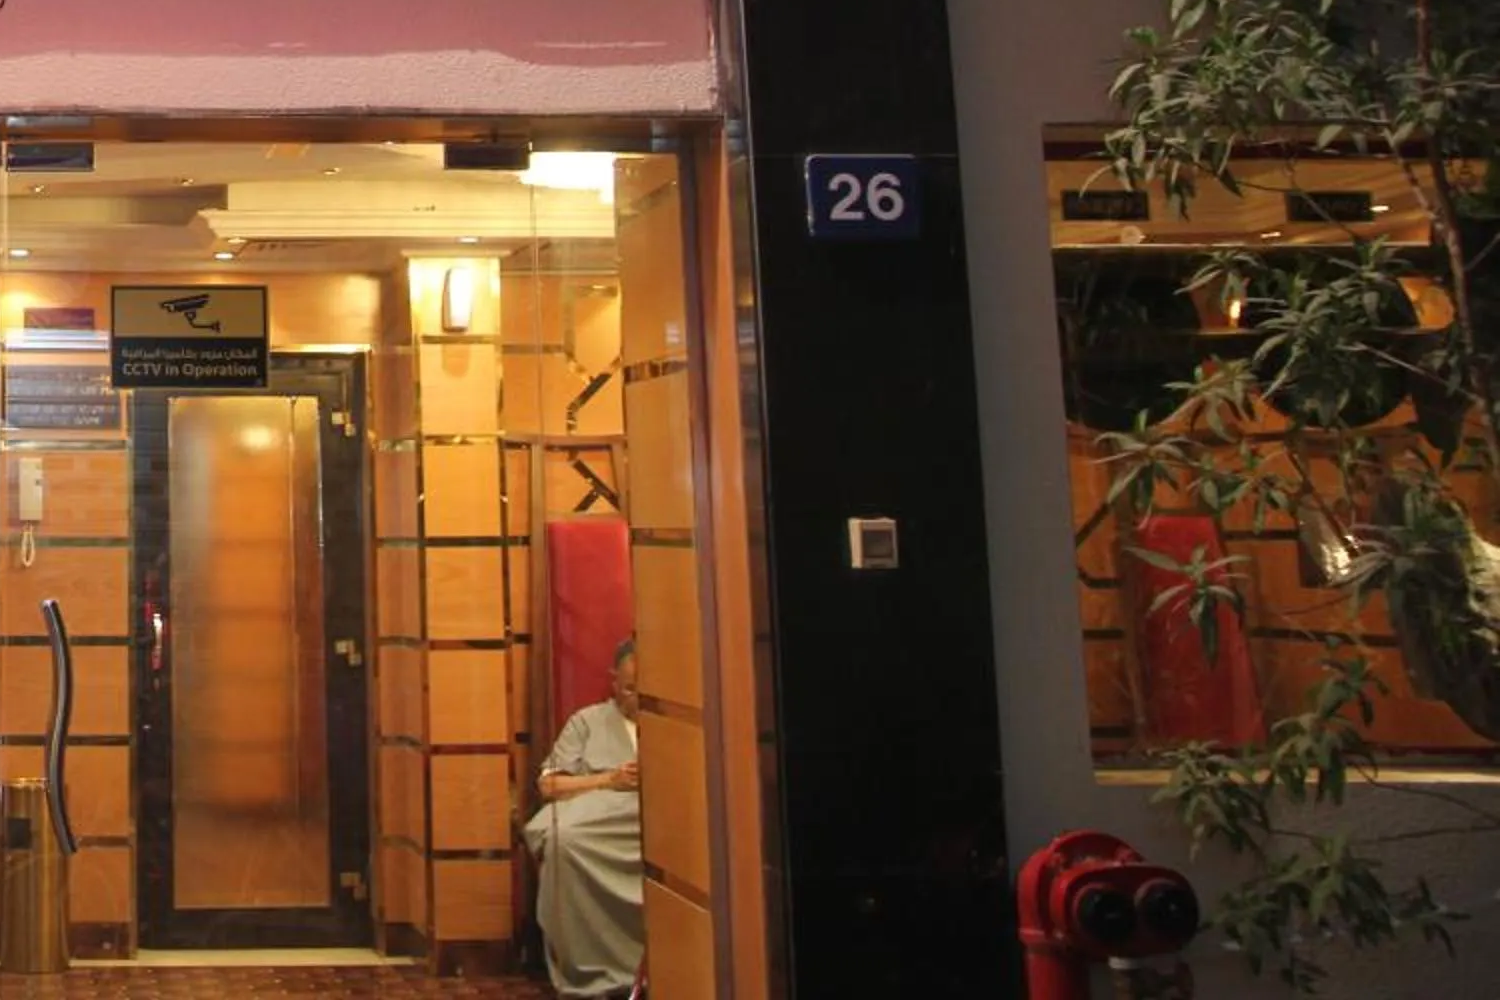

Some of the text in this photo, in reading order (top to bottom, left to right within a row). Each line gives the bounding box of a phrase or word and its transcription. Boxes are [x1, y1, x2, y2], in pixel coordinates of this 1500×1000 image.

[827, 171, 905, 221] 26
[122, 363, 258, 379] CCTV in Operation
